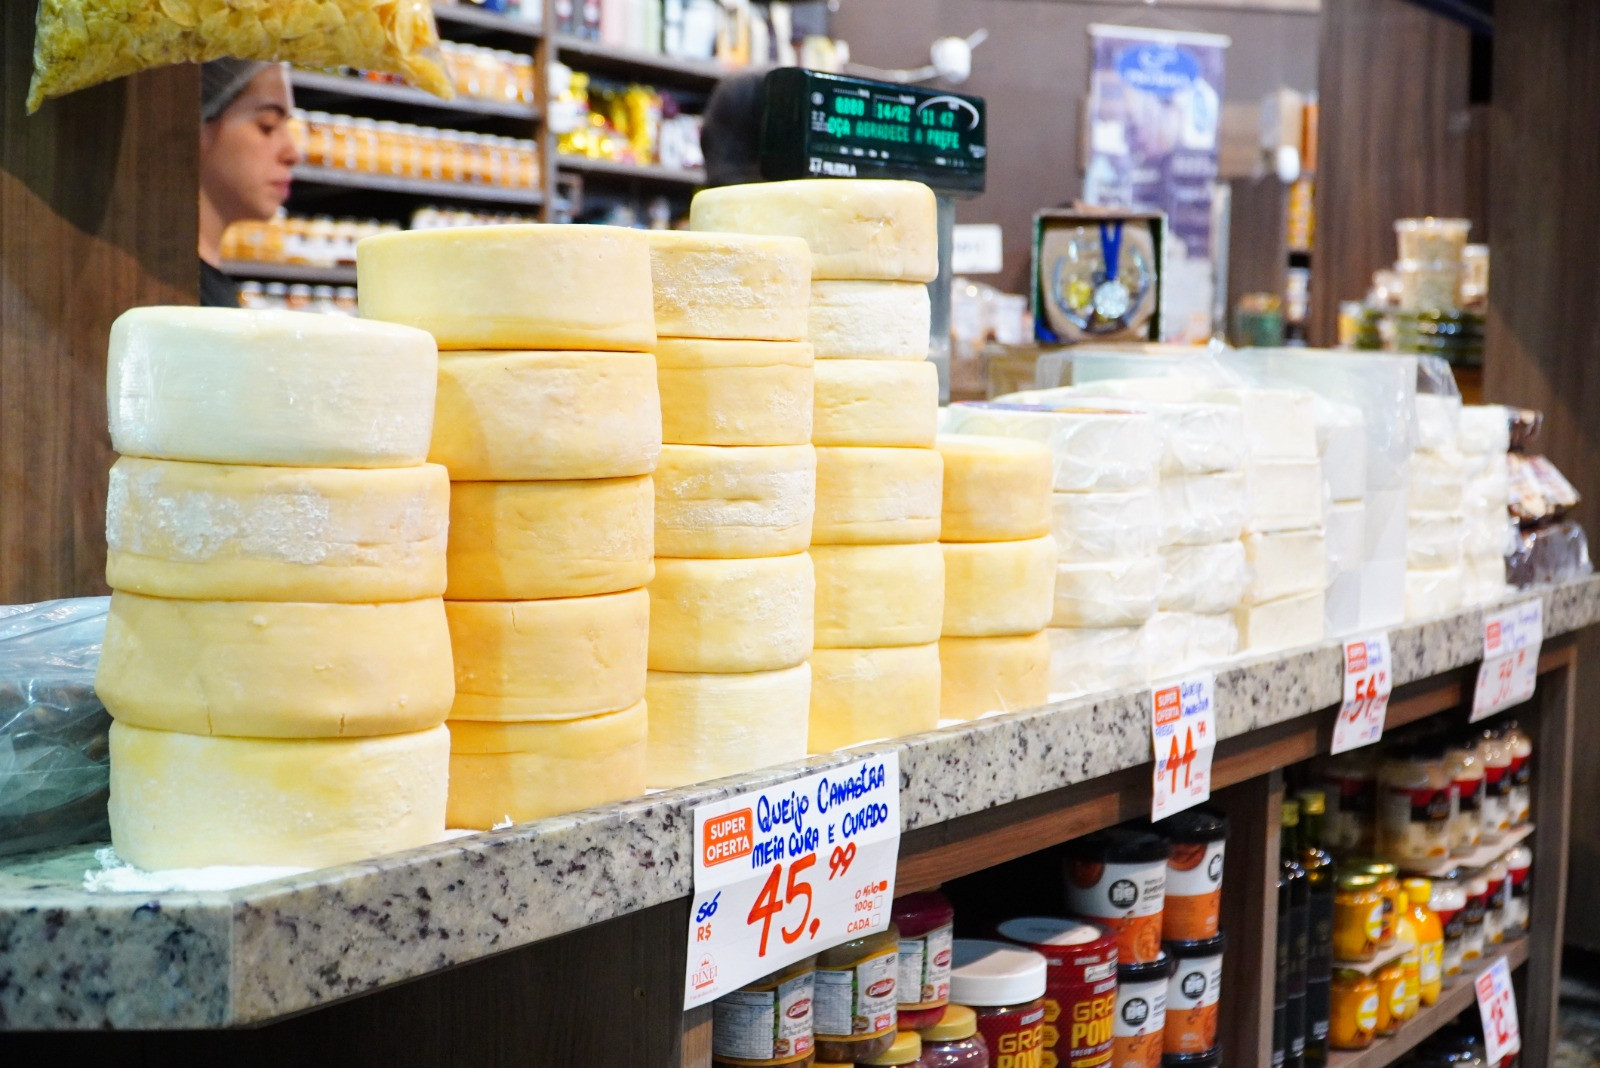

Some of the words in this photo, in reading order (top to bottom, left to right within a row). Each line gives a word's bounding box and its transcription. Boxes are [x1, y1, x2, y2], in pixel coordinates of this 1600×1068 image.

[1157, 692, 1178, 707] SUPER
[1156, 705, 1180, 723] OFERTA
[710, 816, 746, 840] SUPER
[788, 826, 819, 857] CURA
[828, 823, 835, 844] E
[842, 803, 888, 838] CURADO
[706, 835, 751, 862] OFERTA
[829, 842, 857, 880] 99
[854, 899, 873, 913] 100g
[697, 922, 712, 942] R$
[847, 918, 870, 933] CADA
